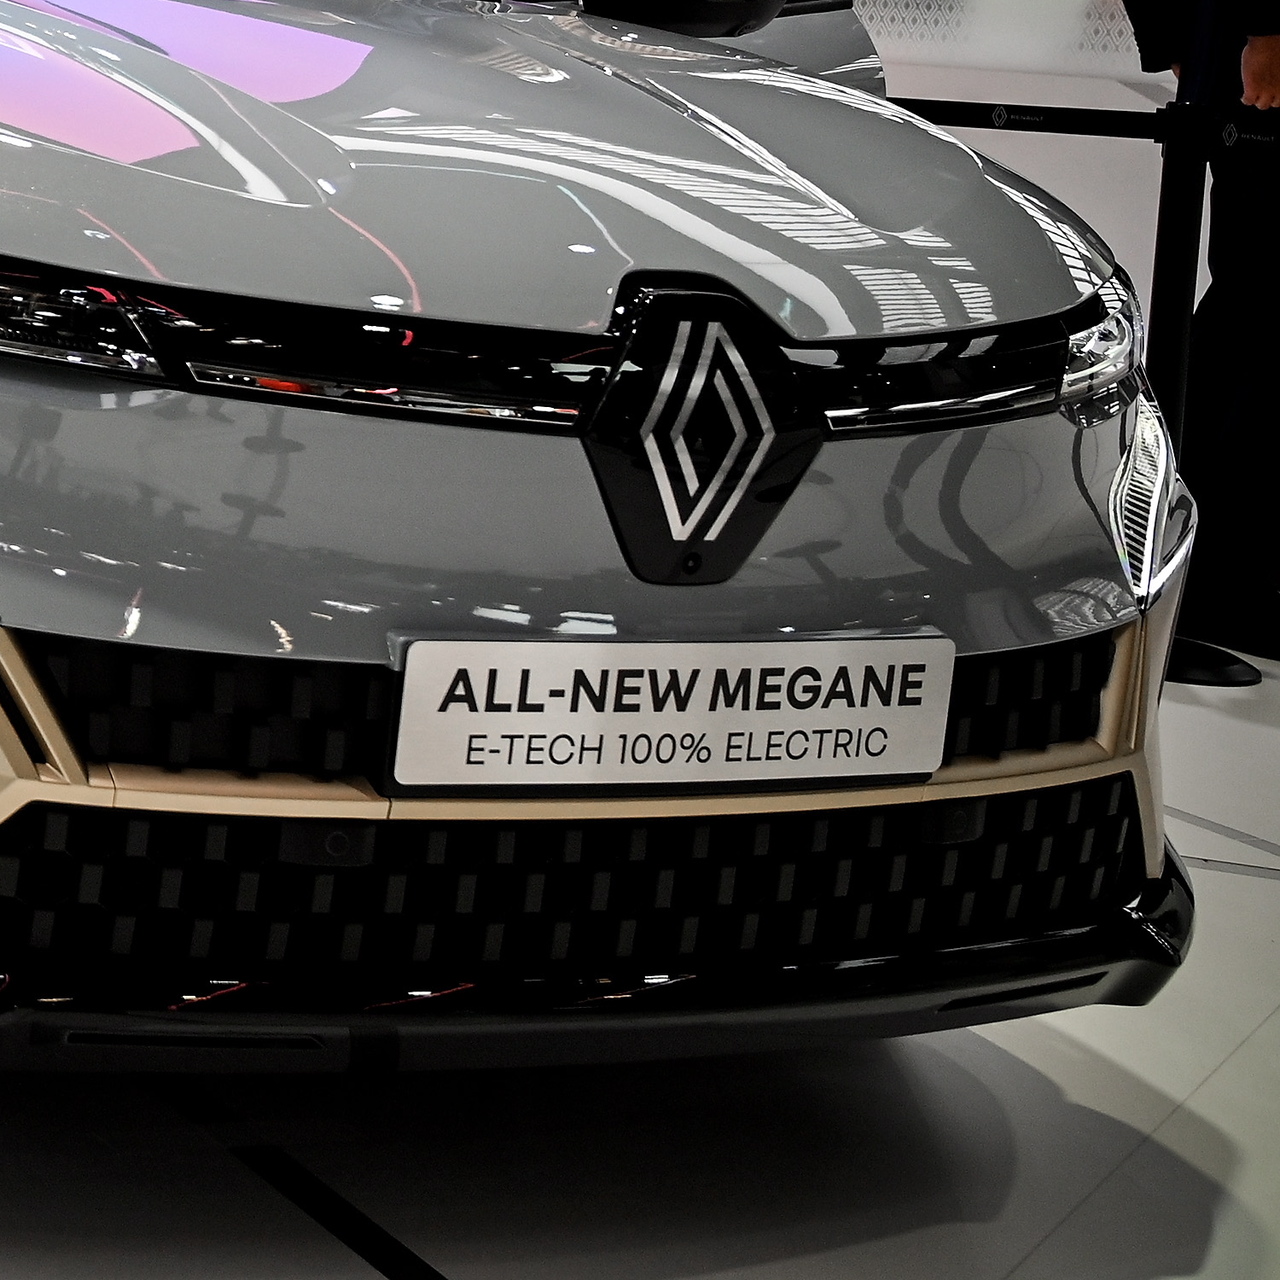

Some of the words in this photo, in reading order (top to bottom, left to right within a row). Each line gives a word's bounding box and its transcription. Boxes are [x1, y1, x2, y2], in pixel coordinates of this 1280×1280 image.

[437, 666, 701, 714] ALL-NEW
[708, 663, 927, 712] MEGANE
[465, 733, 604, 766] E-TECH
[618, 732, 713, 765] 100%
[724, 726, 889, 763] ELECTRIC
